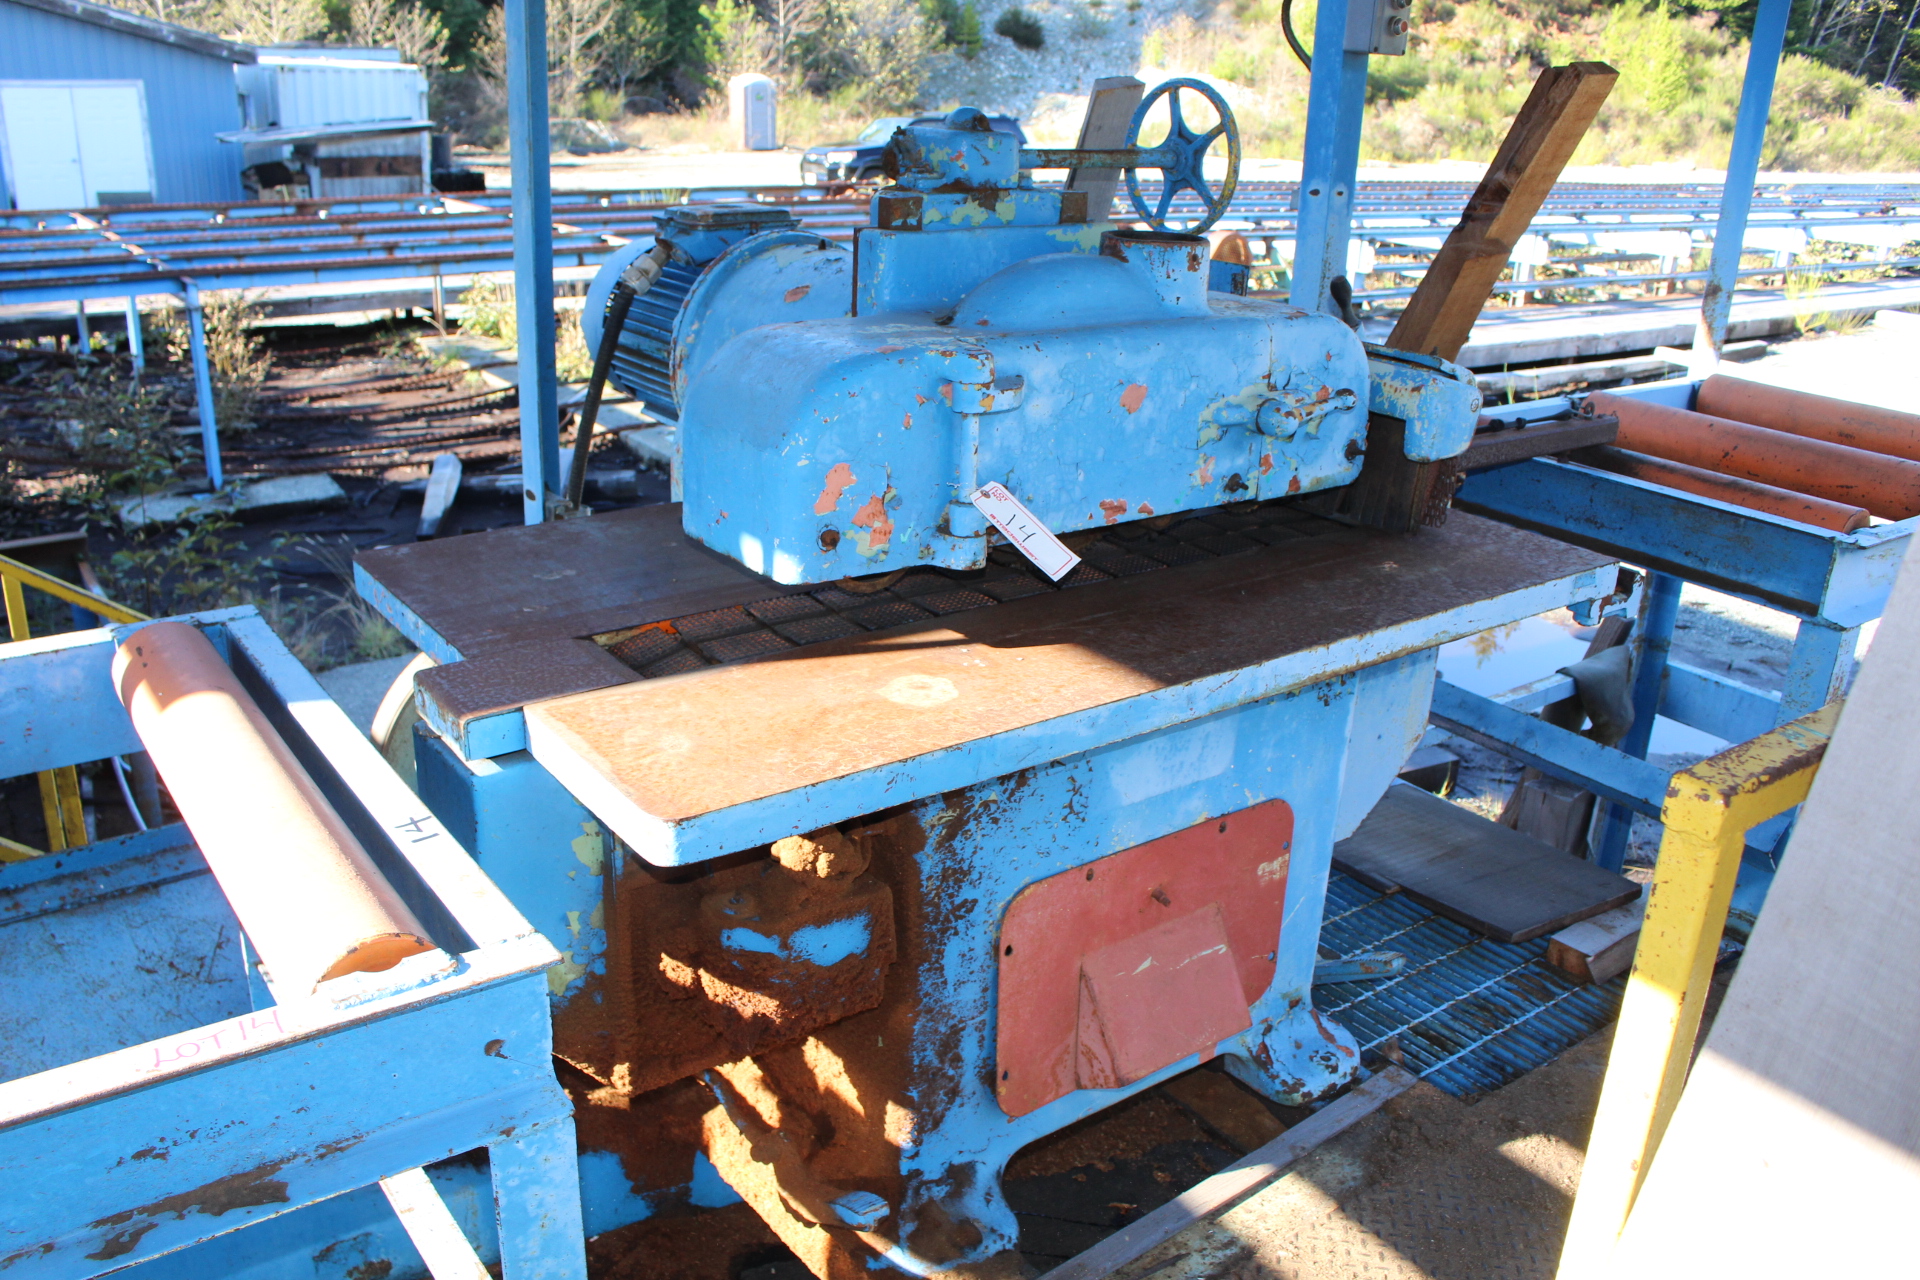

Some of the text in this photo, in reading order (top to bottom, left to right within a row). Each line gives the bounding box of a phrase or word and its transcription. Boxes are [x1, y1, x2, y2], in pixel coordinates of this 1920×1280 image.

[991, 491, 1003, 503] NO.
[994, 489, 1009, 502] LOT
[1005, 513, 1036, 543] 14
[394, 815, 440, 843] 14
[153, 1009, 284, 1068] LOT 14
